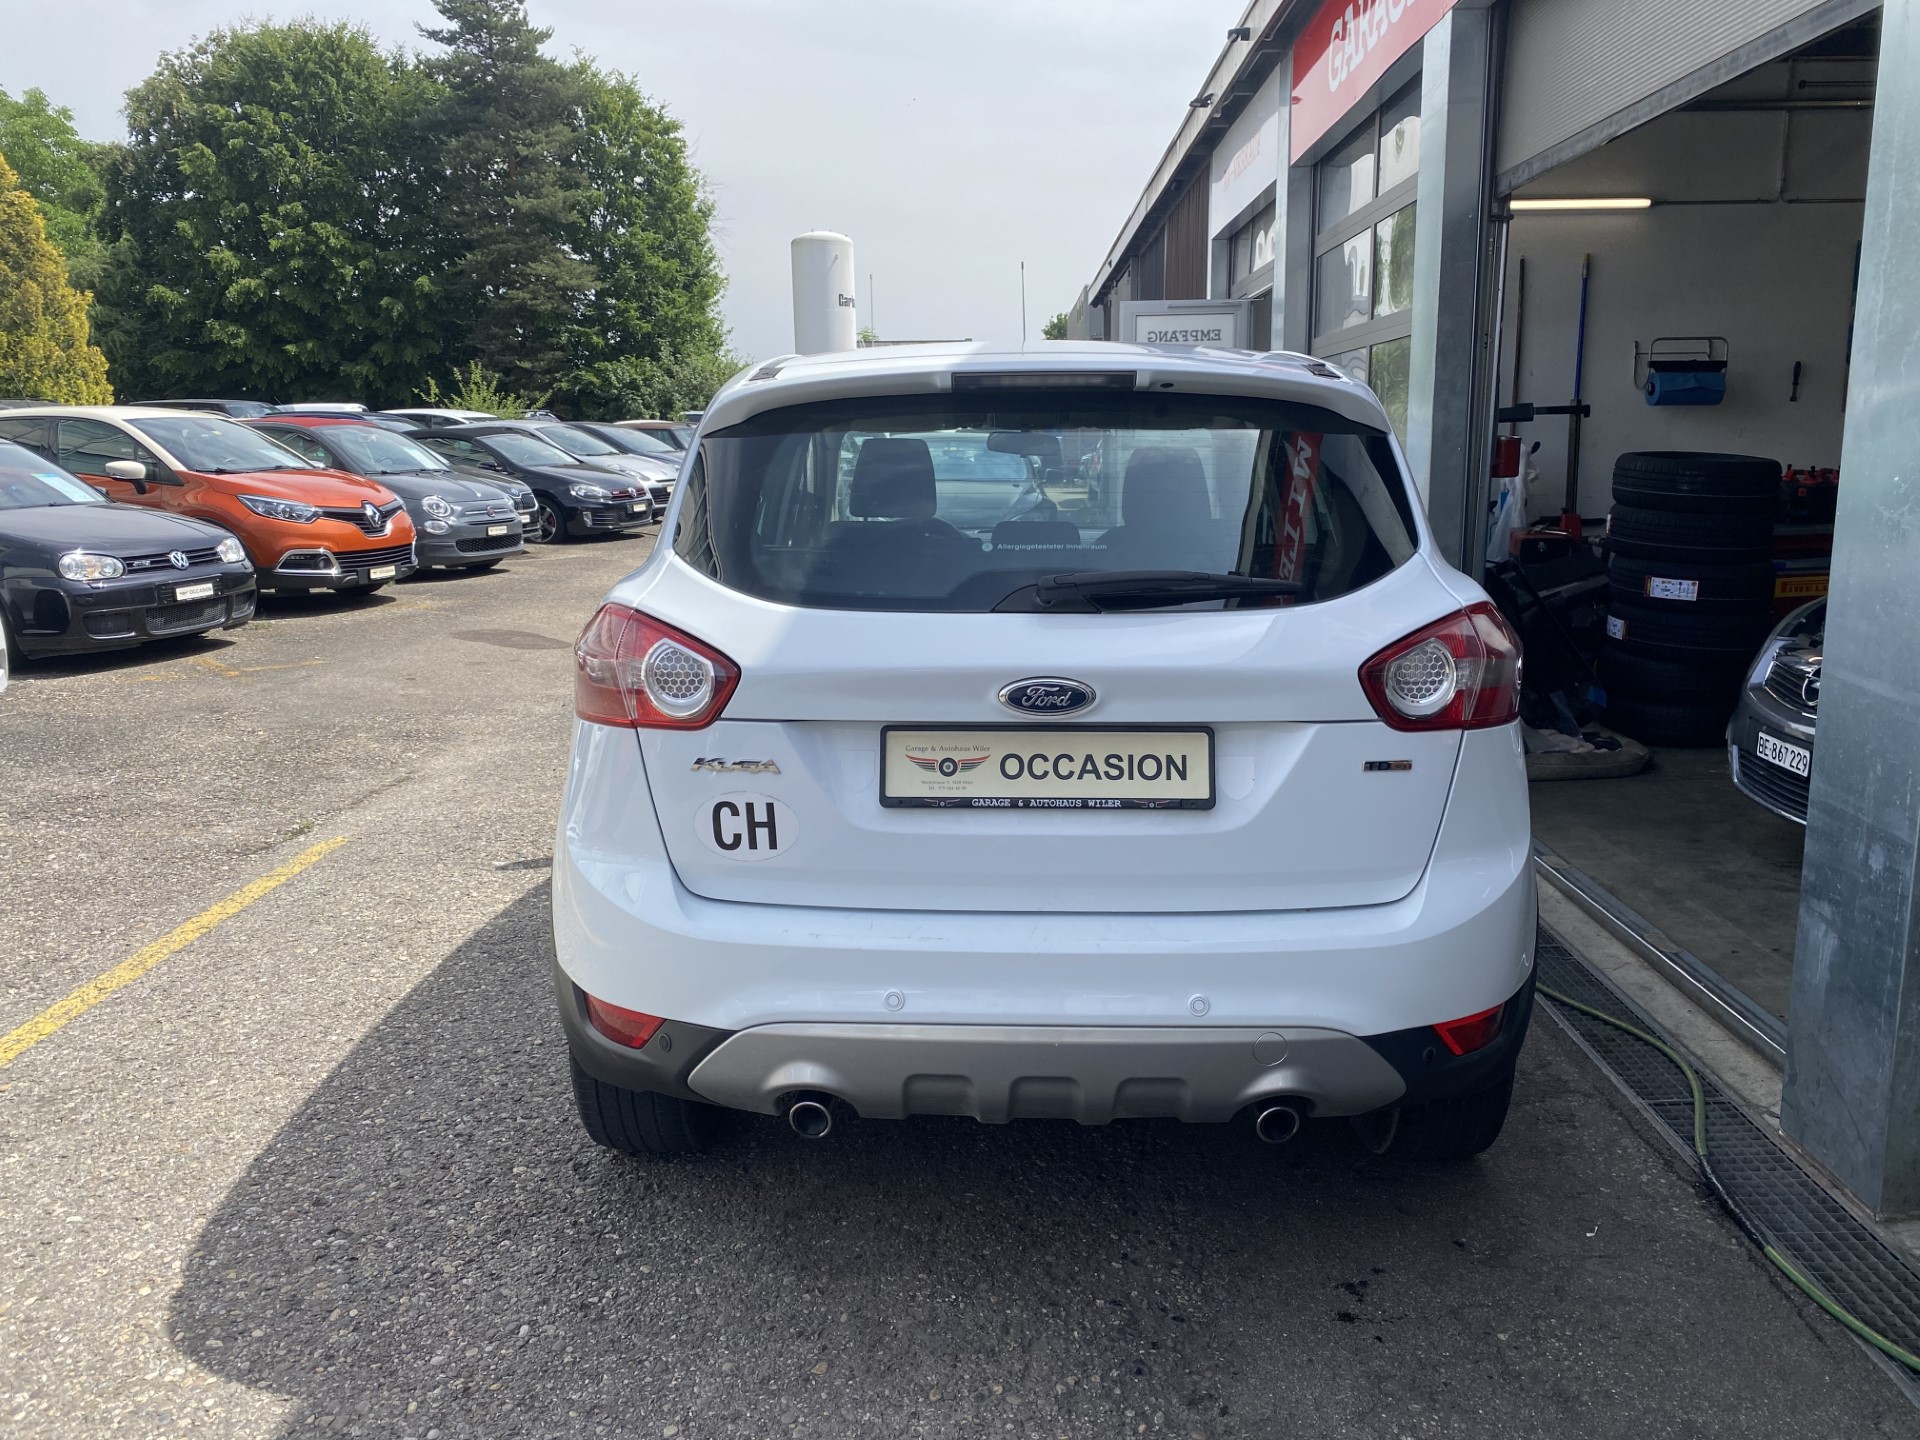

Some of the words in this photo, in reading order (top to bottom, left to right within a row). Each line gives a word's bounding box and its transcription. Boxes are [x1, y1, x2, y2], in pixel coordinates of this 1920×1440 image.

[1328, 0, 1416, 93] GARA
[1021, 686, 1072, 707] Ford
[905, 745, 928, 753] Garage
[1000, 753, 1187, 781] OCCASION
[971, 798, 1011, 807] GARAGE
[1018, 799, 1024, 807] &
[1029, 799, 1082, 807] AUTOHAUS
[1088, 799, 1121, 807] WILER
[712, 801, 778, 851] CH
